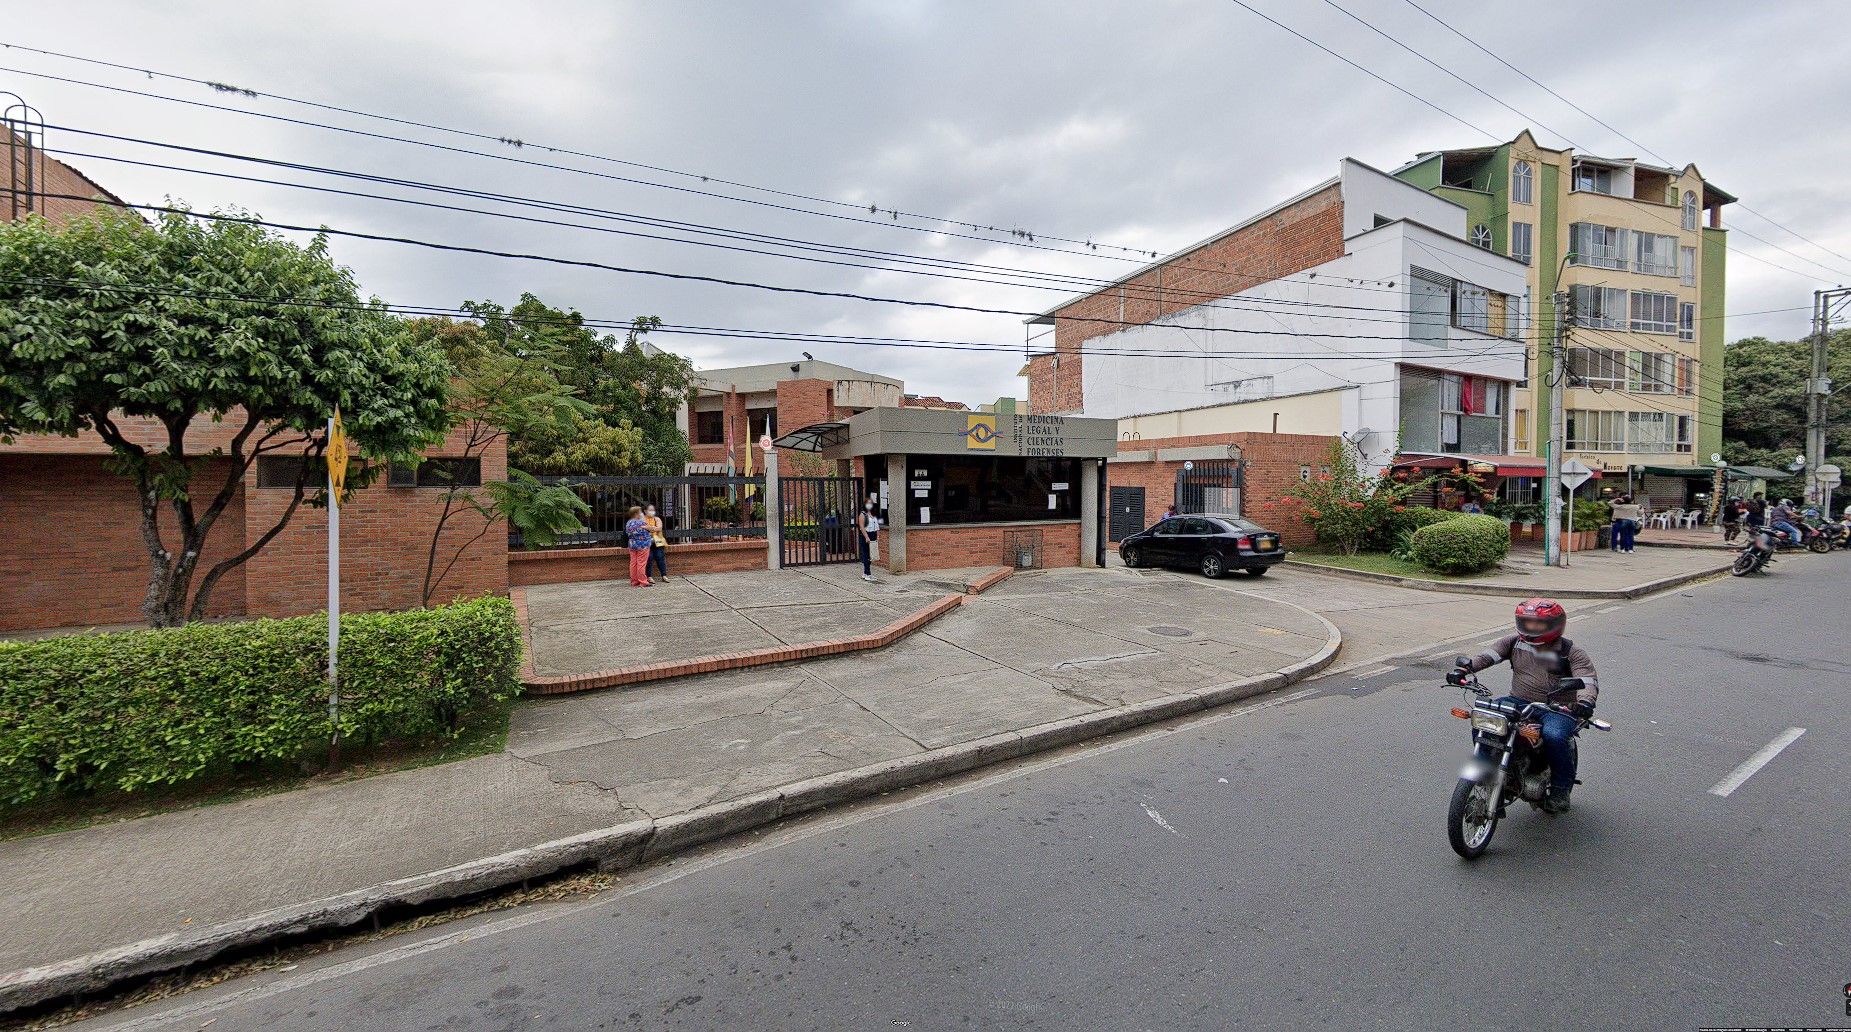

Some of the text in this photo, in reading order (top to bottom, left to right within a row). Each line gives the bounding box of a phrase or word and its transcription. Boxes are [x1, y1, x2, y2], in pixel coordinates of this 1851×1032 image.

[1026, 414, 1064, 424] MEDICINA
[1027, 426, 1060, 434] LEGAL Y
[1026, 436, 1064, 446] CIENCIAS
[1026, 448, 1064, 456] FORENSES
